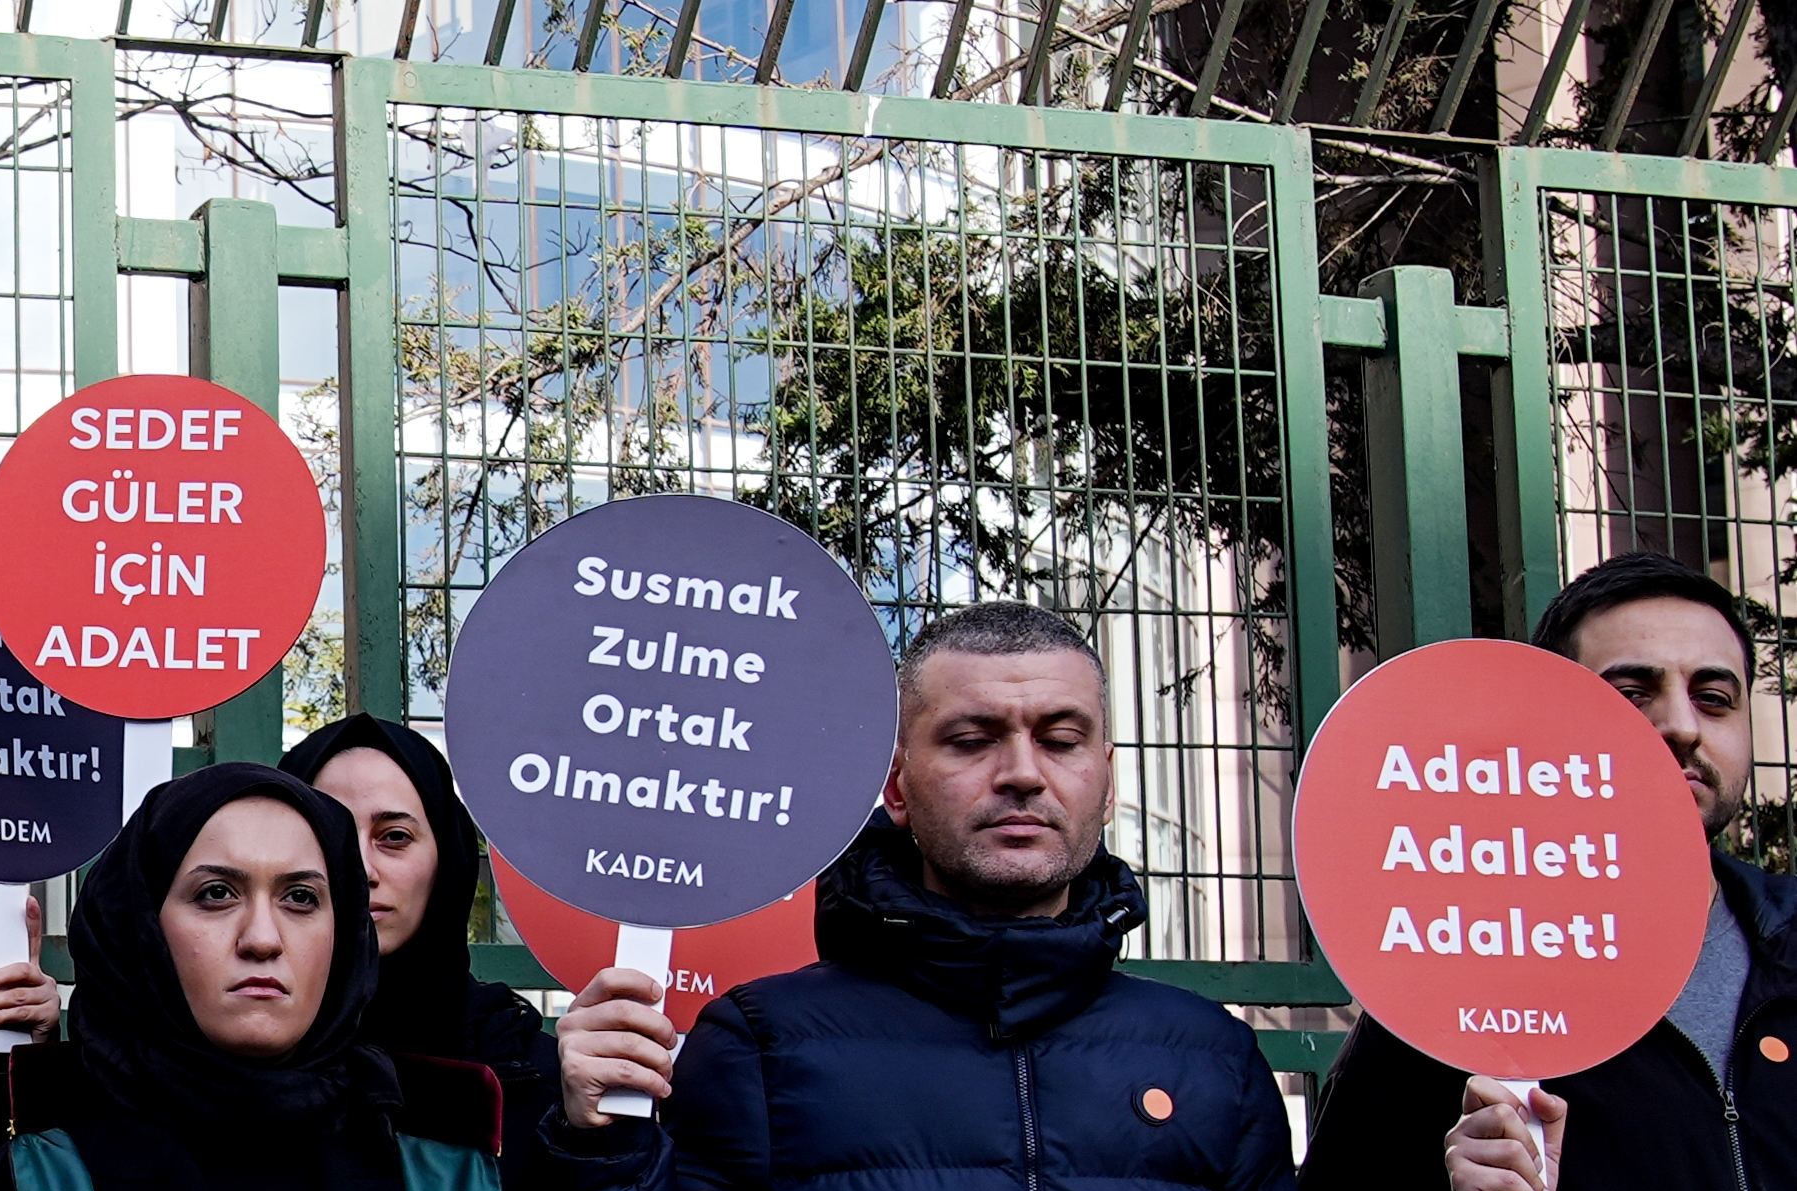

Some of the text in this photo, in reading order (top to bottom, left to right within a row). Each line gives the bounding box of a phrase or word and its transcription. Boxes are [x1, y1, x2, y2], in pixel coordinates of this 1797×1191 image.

[70, 408, 241, 450] SEDEF
[63, 470, 242, 523] GÜLER
[95, 541, 205, 605] İÇİN
[574, 557, 799, 619] Susmak
[35, 626, 260, 669] ADALET
[589, 626, 764, 683] Zulme
[583, 694, 752, 751] Ortak
[510, 753, 793, 826] Olmaktır!
[1377, 745, 1613, 798] Adalet!
[585, 849, 704, 887] KADEM
[1382, 825, 1619, 878] Adalet!
[1380, 906, 1617, 959] Adalet!
[1458, 1007, 1567, 1035] KADEM
